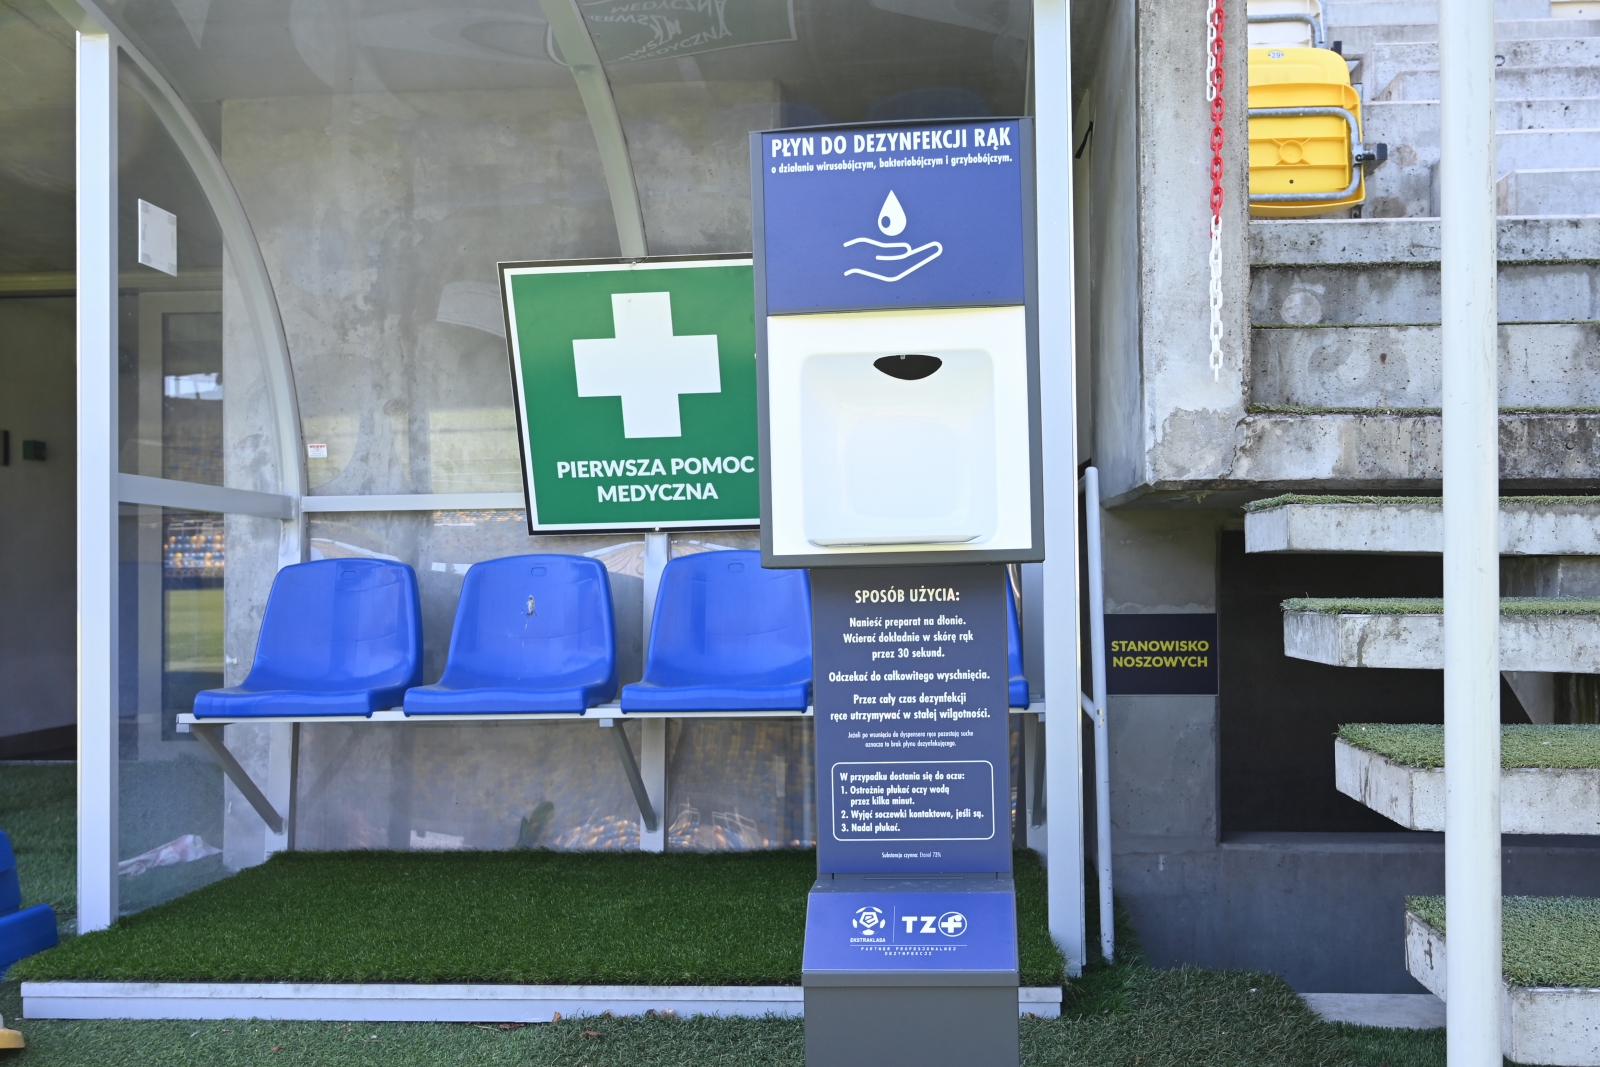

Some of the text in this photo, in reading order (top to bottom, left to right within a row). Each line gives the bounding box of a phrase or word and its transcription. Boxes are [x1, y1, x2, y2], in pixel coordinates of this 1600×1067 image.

[771, 127, 1011, 158] PŁYN DO DEZYNFEKCJI RĄK
[779, 162, 814, 173] działaniu
[816, 160, 876, 172] wirusobójczym,
[880, 157, 943, 168] bakteriobójczym
[951, 154, 1012, 167] grzybobójczym.
[557, 456, 755, 478] PIERWSZA POMOC
[597, 483, 718, 502] MEDYCZNA
[855, 585, 960, 604] SPOSÓB UŻYCIA:
[850, 615, 966, 629] Nanieść preparat na dłonie.
[843, 630, 973, 643] Wcierać dokładnie w skórę rąk
[1111, 640, 1209, 651] STANOWISKO
[872, 647, 945, 661] przez 30 sekund.
[1113, 656, 1207, 667] NOSZOWYCH
[828, 669, 990, 683] Odczekać do całkowitego wyschnięcia.
[853, 694, 876, 704] Przez
[879, 693, 896, 706] cały
[919, 692, 966, 705] dezynfekcji
[830, 712, 847, 722] ręce
[850, 710, 900, 722] utrzymywać
[914, 708, 937, 721] stałej
[939, 708, 990, 721] wilgotności.
[840, 773, 848, 781] W
[850, 772, 887, 783] przypadku
[890, 772, 920, 780] dostania
[922, 772, 932, 781] się
[935, 771, 944, 780] do
[841, 784, 950, 796] 1. Ostrożnie płukać oczy wodą
[850, 798, 869, 807] przez
[872, 796, 889, 805] kilka
[841, 808, 984, 820] 2. Wyjąć soczewki kontaktowe, jeśli są.
[841, 823, 900, 834] 3. Nadal płukać.
